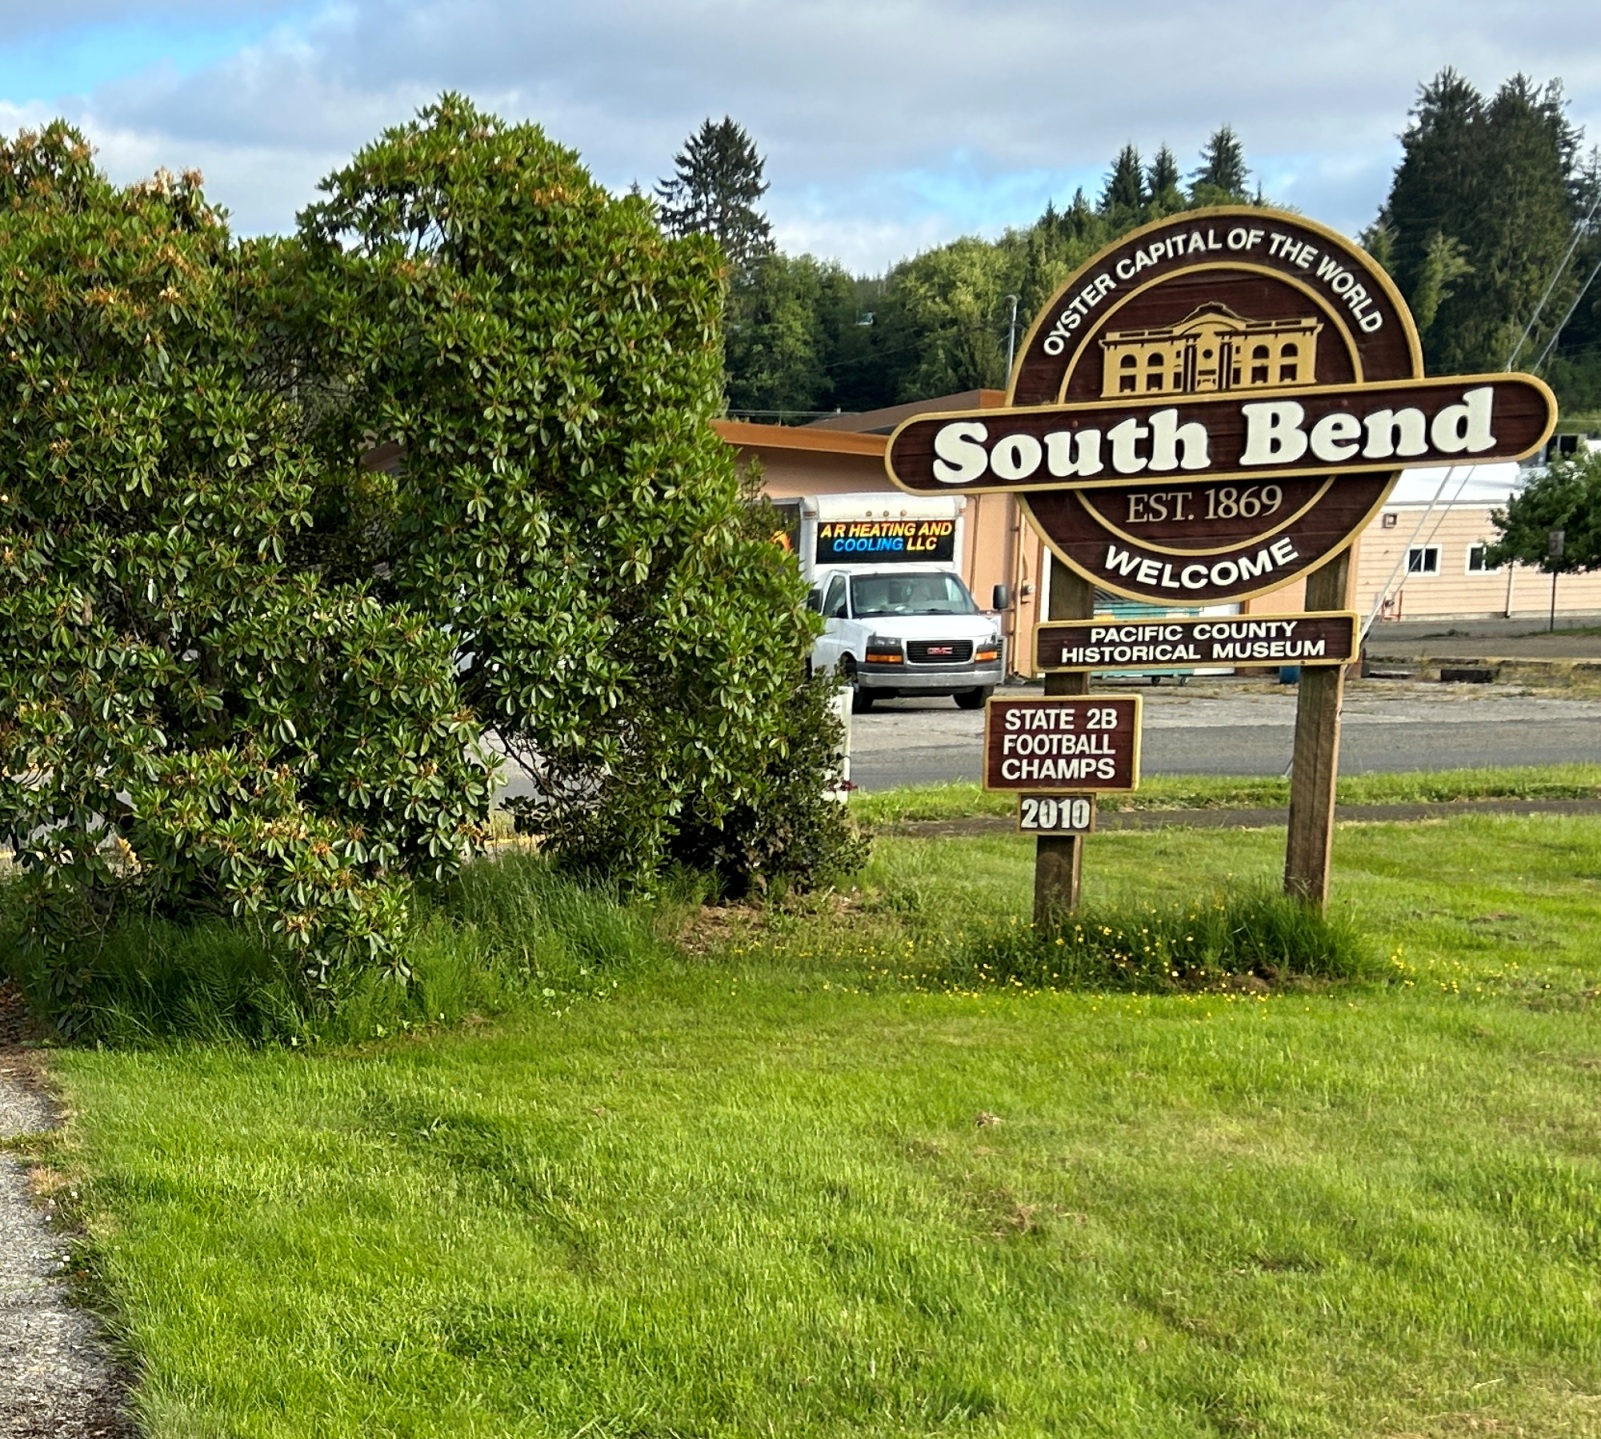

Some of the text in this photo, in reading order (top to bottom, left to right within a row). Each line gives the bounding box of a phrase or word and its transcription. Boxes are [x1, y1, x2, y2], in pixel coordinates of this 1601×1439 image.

[1043, 227, 1384, 357] OYSTER CAPITAL OF THE WORLD
[932, 386, 1498, 485] South Bend
[1125, 484, 1283, 524] EST. 1869
[848, 522, 916, 538] HEATING
[918, 522, 953, 536] AND
[833, 536, 938, 552] COOLING LLC
[1104, 536, 1300, 591] WELCOME
[1090, 621, 1298, 644] PACIFIC COUNTY
[1061, 639, 1326, 663] HISTORICAL MUSEUM
[1004, 708, 1118, 731] STATE 2B
[1003, 734, 1116, 755] FOOTBALL
[1001, 758, 1116, 780] CHAMPS
[1020, 798, 1091, 830] 2010
